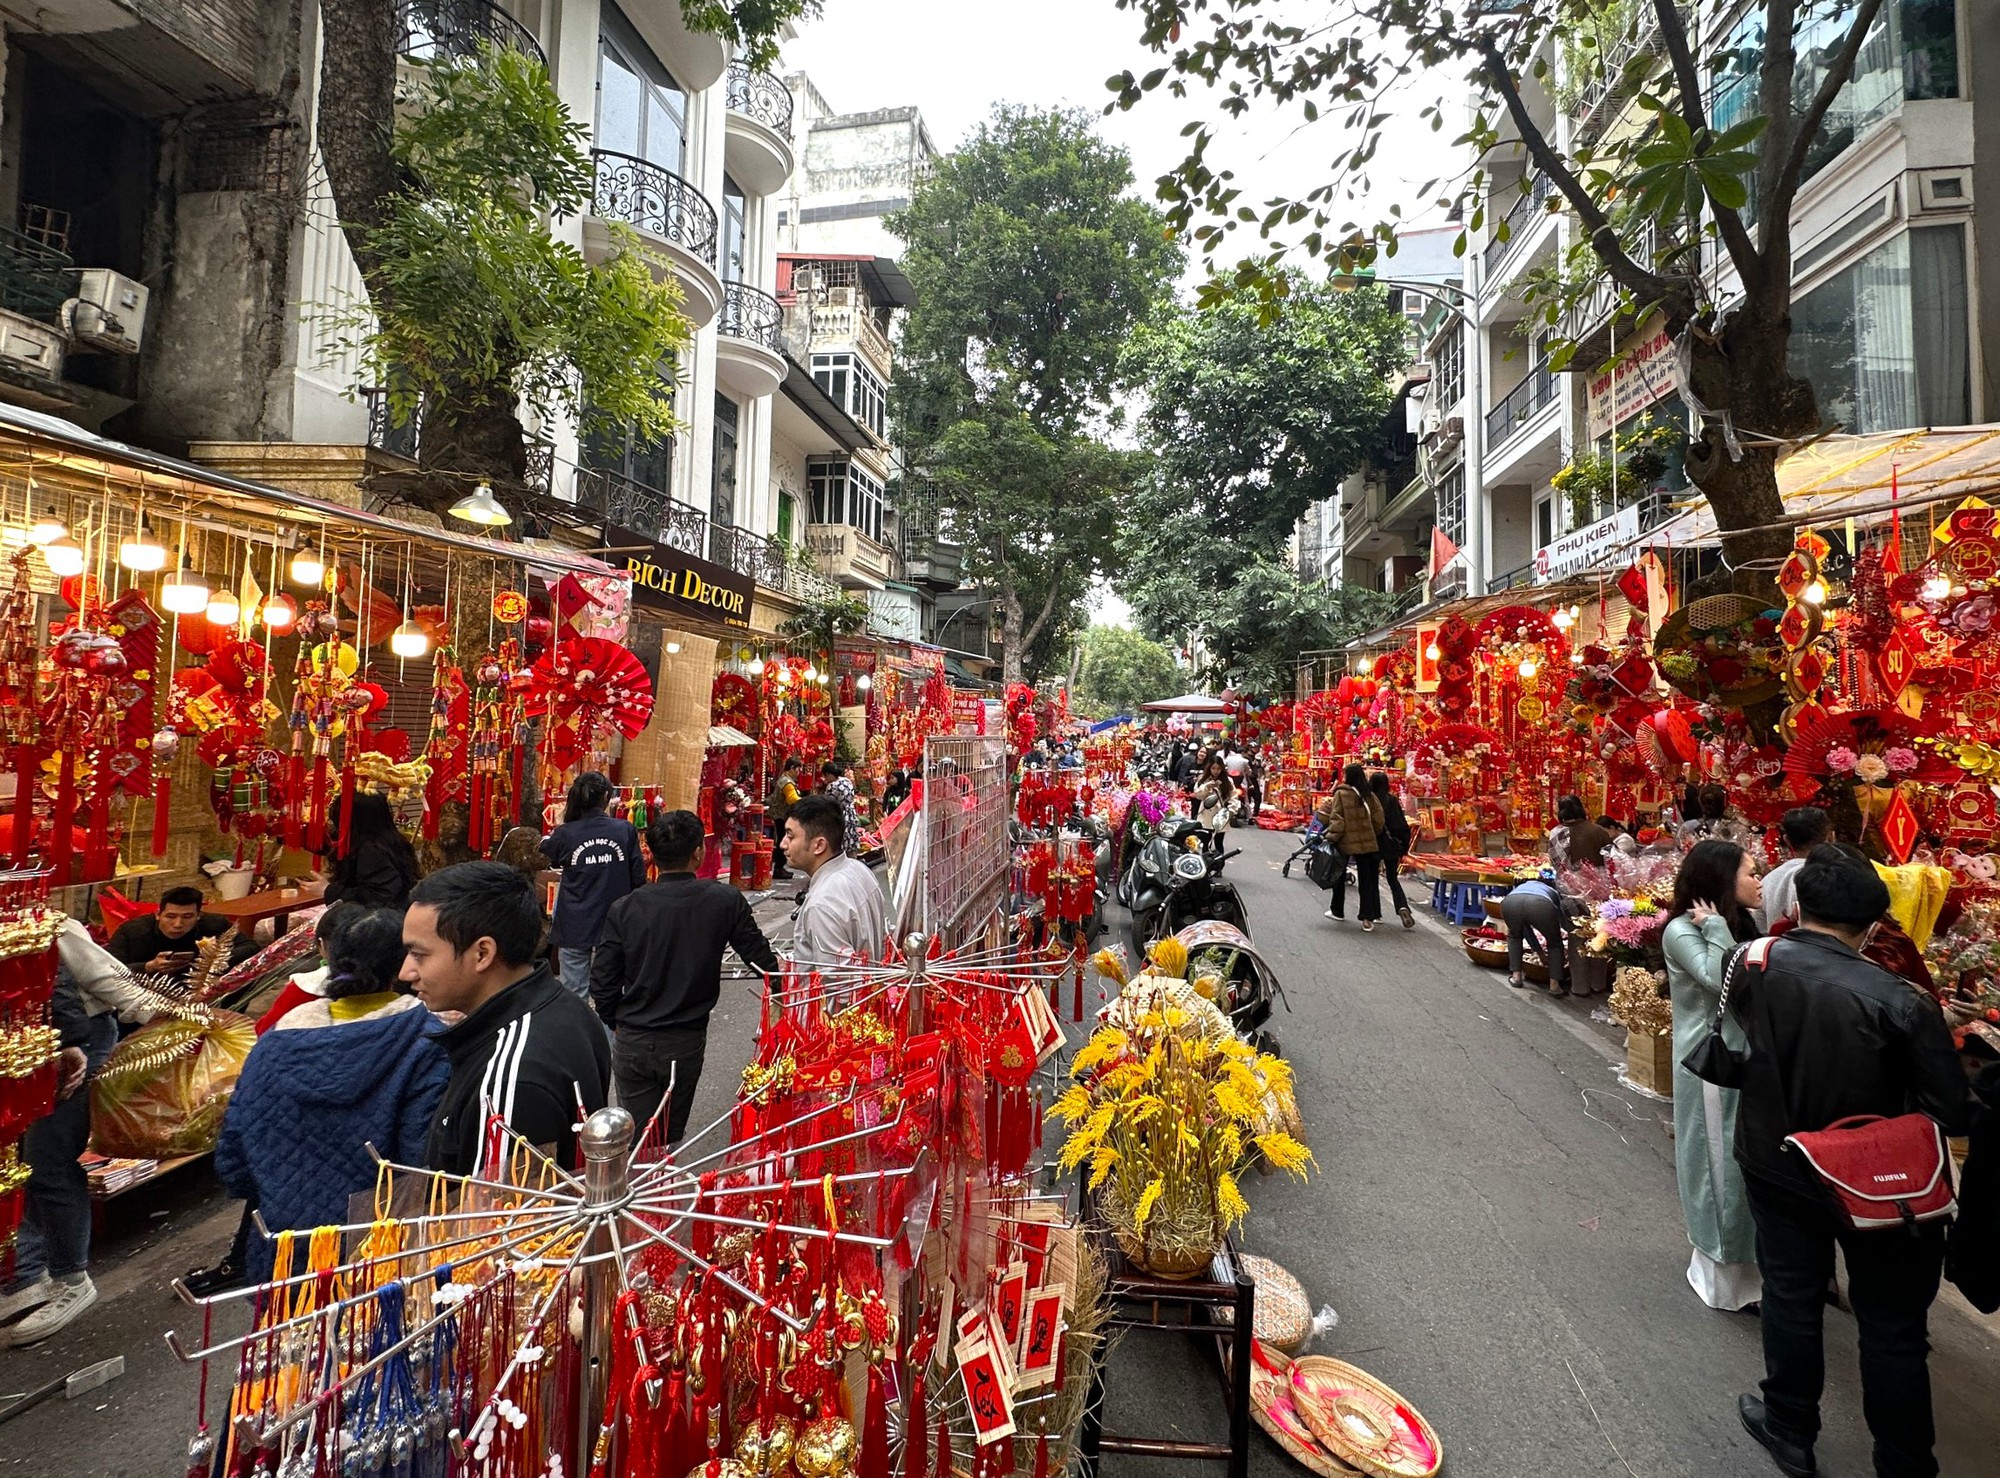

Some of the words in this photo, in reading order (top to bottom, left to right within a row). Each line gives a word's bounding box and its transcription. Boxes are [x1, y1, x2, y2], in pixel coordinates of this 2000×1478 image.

[1557, 536, 1583, 556] PHỤ
[1586, 520, 1618, 543] KIỆN
[626, 554, 677, 594] BÍCH
[681, 568, 744, 614] DECOR
[585, 855, 596, 864] HÀ
[598, 853, 612, 864] NỘI
[1873, 1173, 1907, 1182] FUJIFILM
